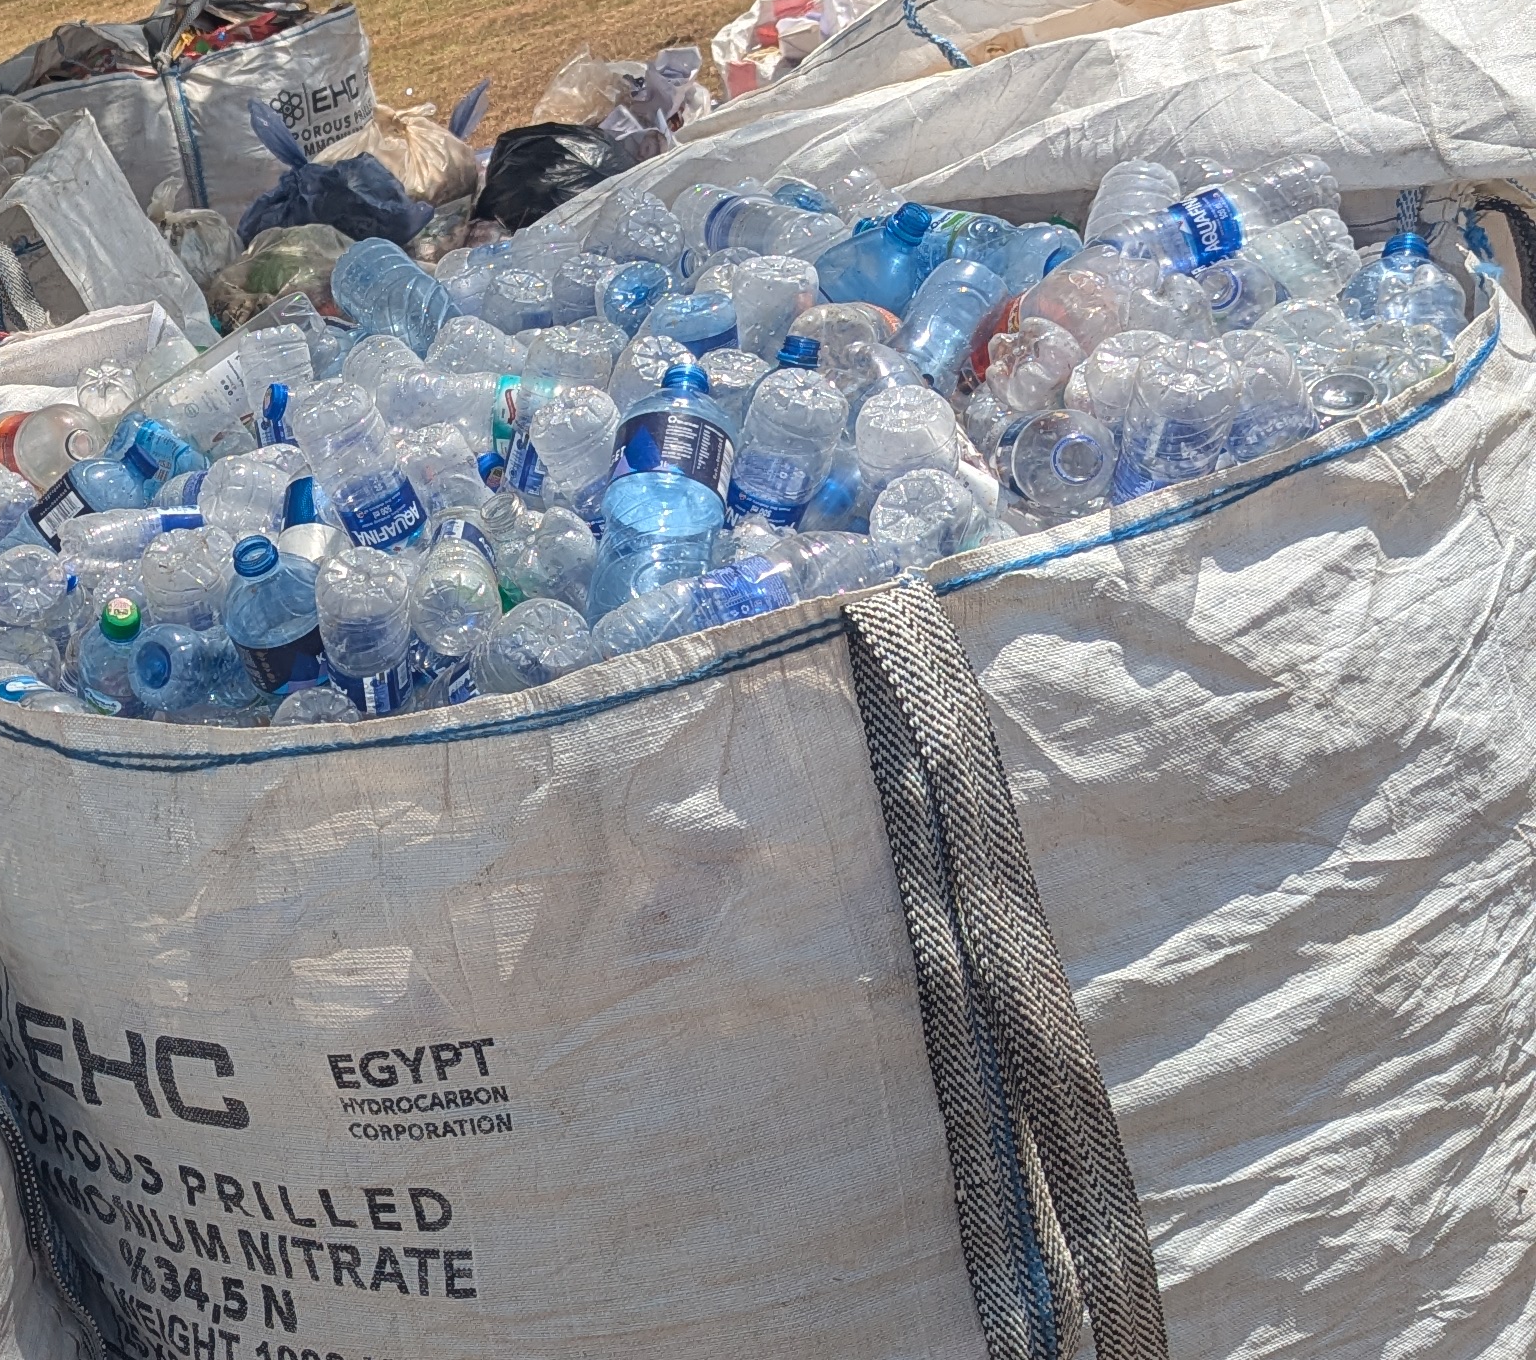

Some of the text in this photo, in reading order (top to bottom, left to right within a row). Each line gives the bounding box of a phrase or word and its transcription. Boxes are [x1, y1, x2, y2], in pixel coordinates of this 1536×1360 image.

[312, 74, 359, 114] EHC
[351, 500, 421, 547] AQUAFINA
[17, 1001, 250, 1129] EHC
[327, 1038, 494, 1090] EGYPT
[340, 1083, 509, 1116] HYDROCARBON
[348, 1114, 513, 1141] CORPORATION
[180, 1165, 453, 1233] PRILLED
[239, 1231, 478, 1300] NITRATE
[263, 1284, 298, 1334] N
